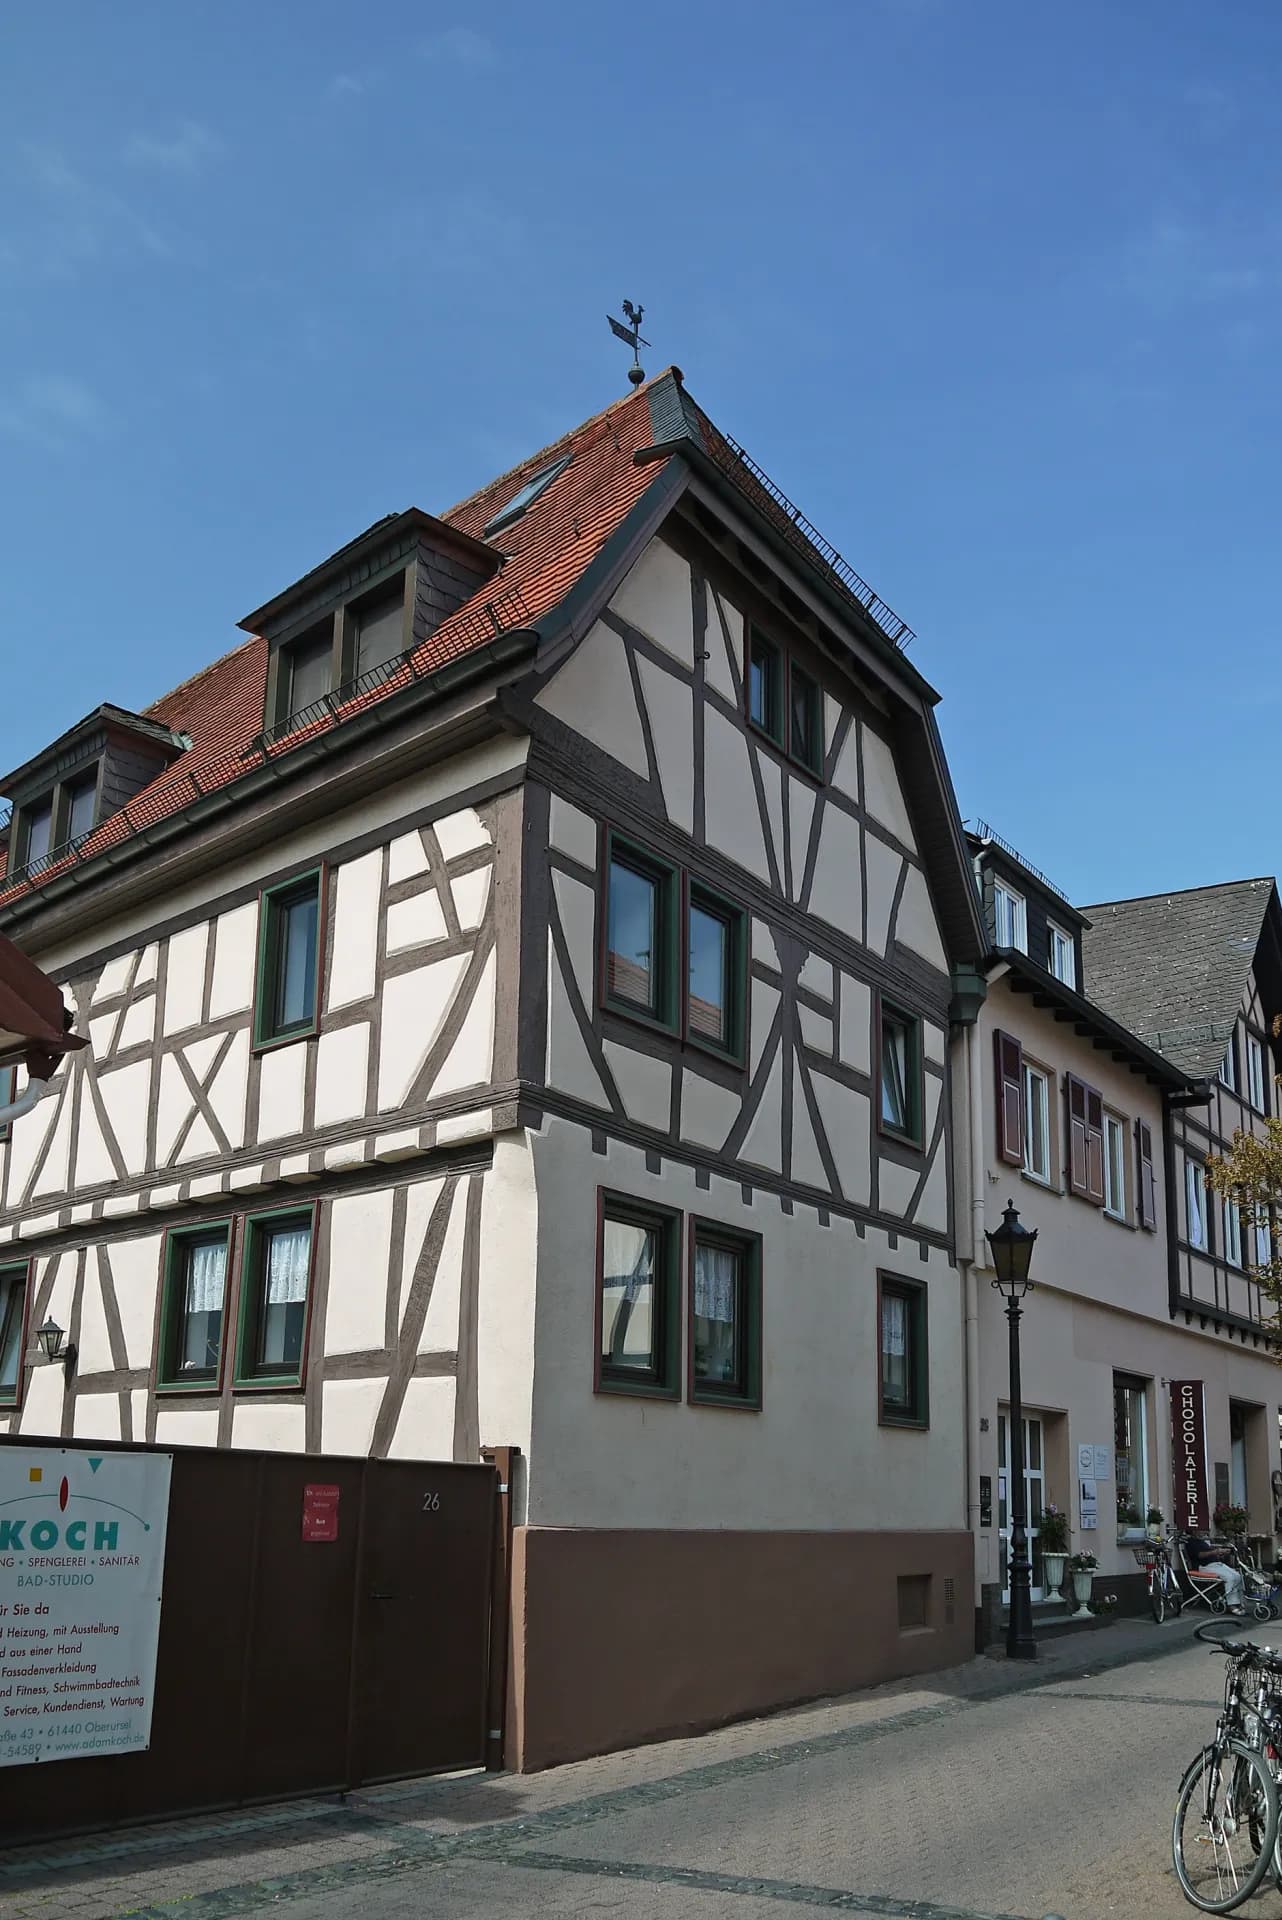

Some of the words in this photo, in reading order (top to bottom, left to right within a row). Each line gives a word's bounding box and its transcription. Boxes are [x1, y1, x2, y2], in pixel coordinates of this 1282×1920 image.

[1181, 1385, 1199, 1527] CHOCOLATERIE
[423, 1492, 440, 1511] 26
[0, 1520, 119, 1551] KOCH
[28, 1557, 87, 1567] SPENGLEREI
[99, 1554, 140, 1566] SANITÄR
[17, 1573, 94, 1587] BAD-STUDIO
[13, 1604, 30, 1616] Sie
[34, 1602, 50, 1615] da
[7, 1628, 49, 1639] Heizung,
[53, 1625, 67, 1636] mit
[70, 1623, 119, 1635] Ausstellung
[10, 1649, 26, 1657] aus
[30, 1647, 54, 1656] einer
[57, 1642, 82, 1654] Hand
[2, 1662, 97, 1677] Fassadenverkleidung
[16, 1686, 49, 1697] Fitness,
[53, 1676, 140, 1693] Schwimmbadtechnik
[4, 1704, 40, 1717] Service,
[43, 1700, 106, 1714] Kundendienst,
[110, 1697, 145, 1707] Wartung
[20, 1728, 34, 1740] 43
[48, 1724, 82, 1737] 61440
[85, 1719, 132, 1734] Oberursel
[56, 1734, 145, 1751] www.adamkoch.de
